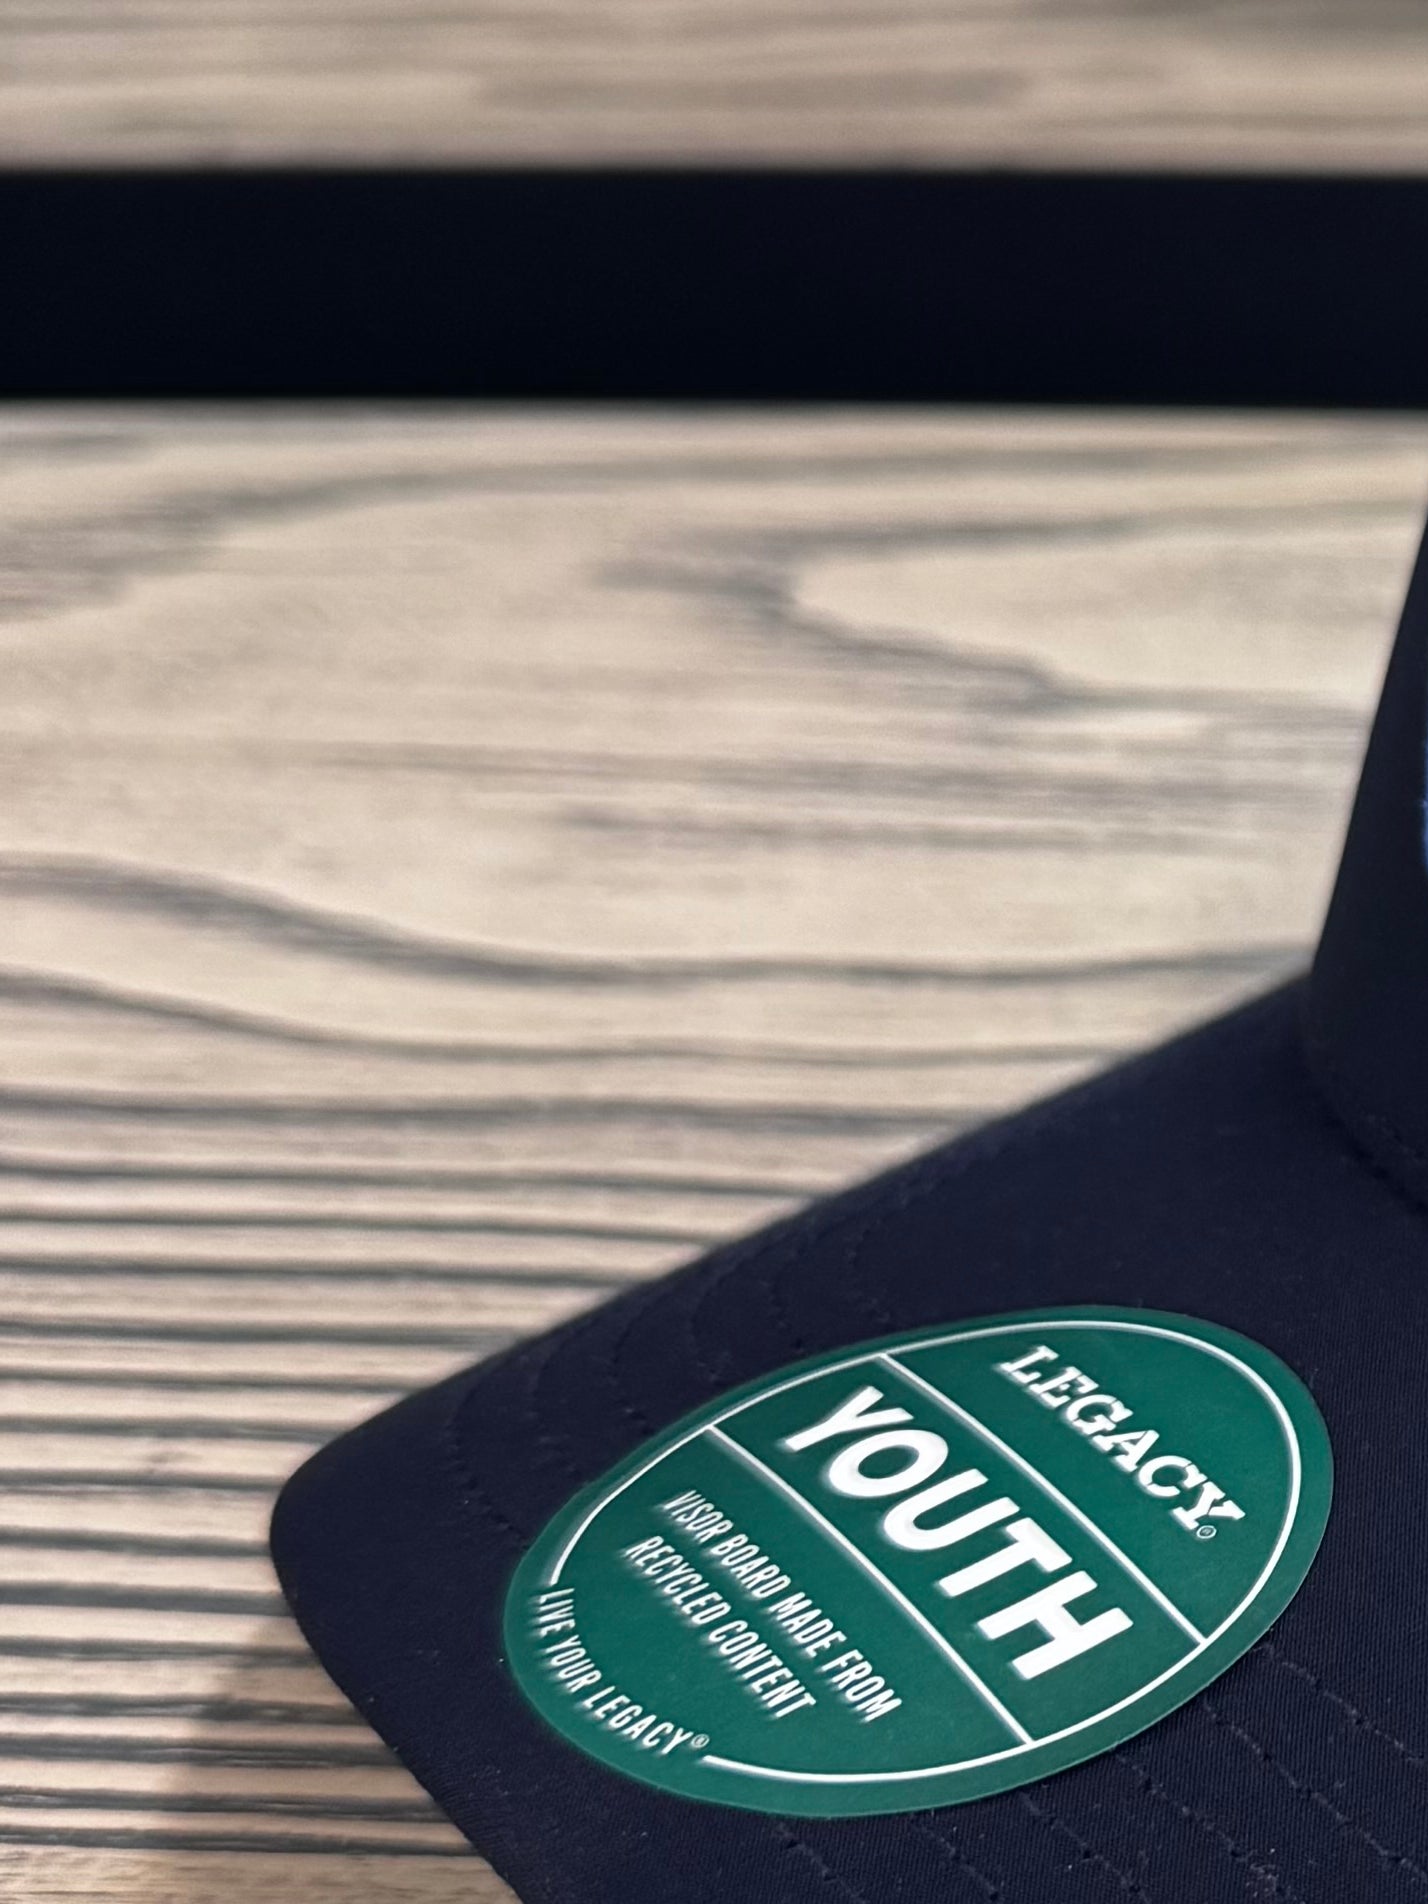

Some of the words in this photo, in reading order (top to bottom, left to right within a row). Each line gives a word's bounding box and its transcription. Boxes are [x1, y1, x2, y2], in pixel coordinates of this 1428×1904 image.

[537, 1588, 576, 1637] LIVE
[660, 1489, 734, 1543] VISOR
[708, 1533, 791, 1599] BOARD
[767, 1591, 846, 1657] MADE
[820, 1649, 902, 1722] FROM
[781, 1385, 1134, 1680] YOUTH
[544, 1634, 602, 1693] YOUR
[624, 1535, 731, 1625] RECYCLED
[707, 1619, 816, 1718] CONTENT
